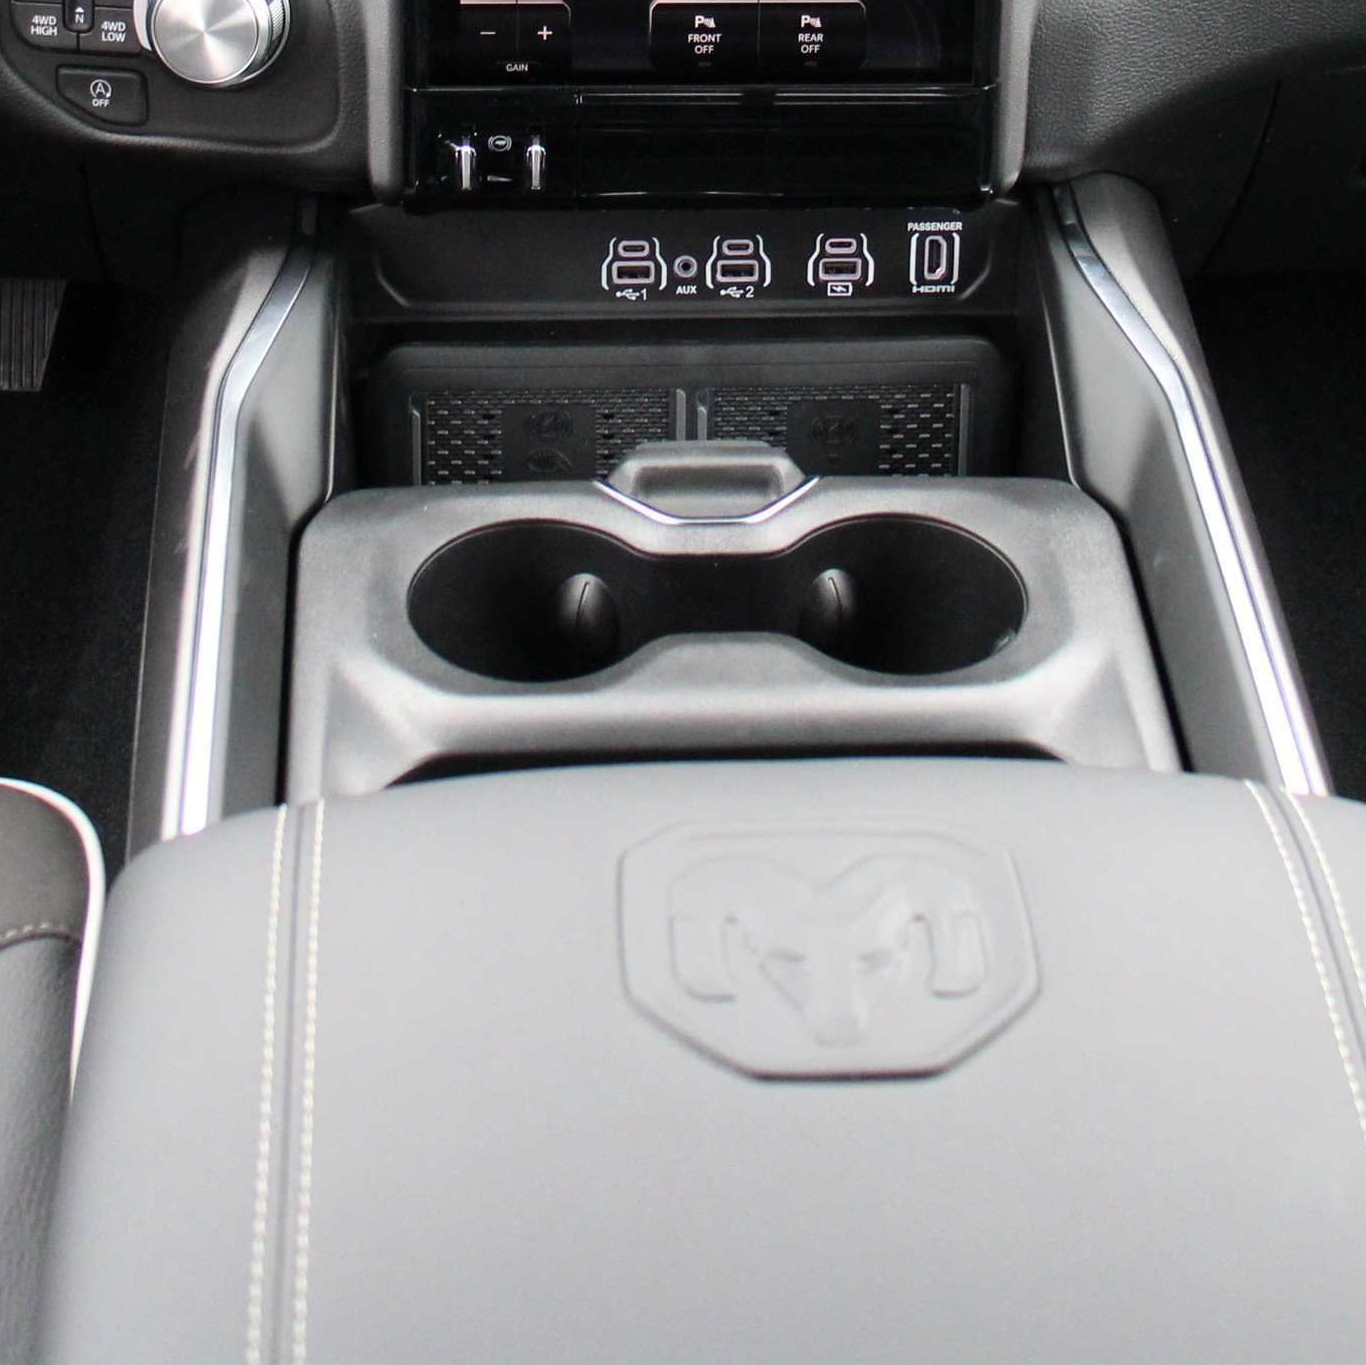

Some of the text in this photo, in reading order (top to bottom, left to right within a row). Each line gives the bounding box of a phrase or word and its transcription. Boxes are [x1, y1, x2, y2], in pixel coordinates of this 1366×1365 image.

[31, 15, 57, 26] 4WD
[75, 14, 84, 24] N
[30, 26, 58, 37] HIGH
[101, 21, 126, 32] 4WD
[101, 32, 126, 43] LOW
[687, 33, 721, 43] FRONT
[797, 33, 824, 43] REAR
[694, 44, 714, 54] OFF
[800, 44, 821, 54] OFF
[505, 63, 528, 72] GAIN
[92, 98, 110, 108] OFF
[907, 221, 963, 232] PASSENGER
[676, 285, 698, 296] AUX
[745, 287, 754, 298] 2
[912, 285, 955, 294] HDMI
